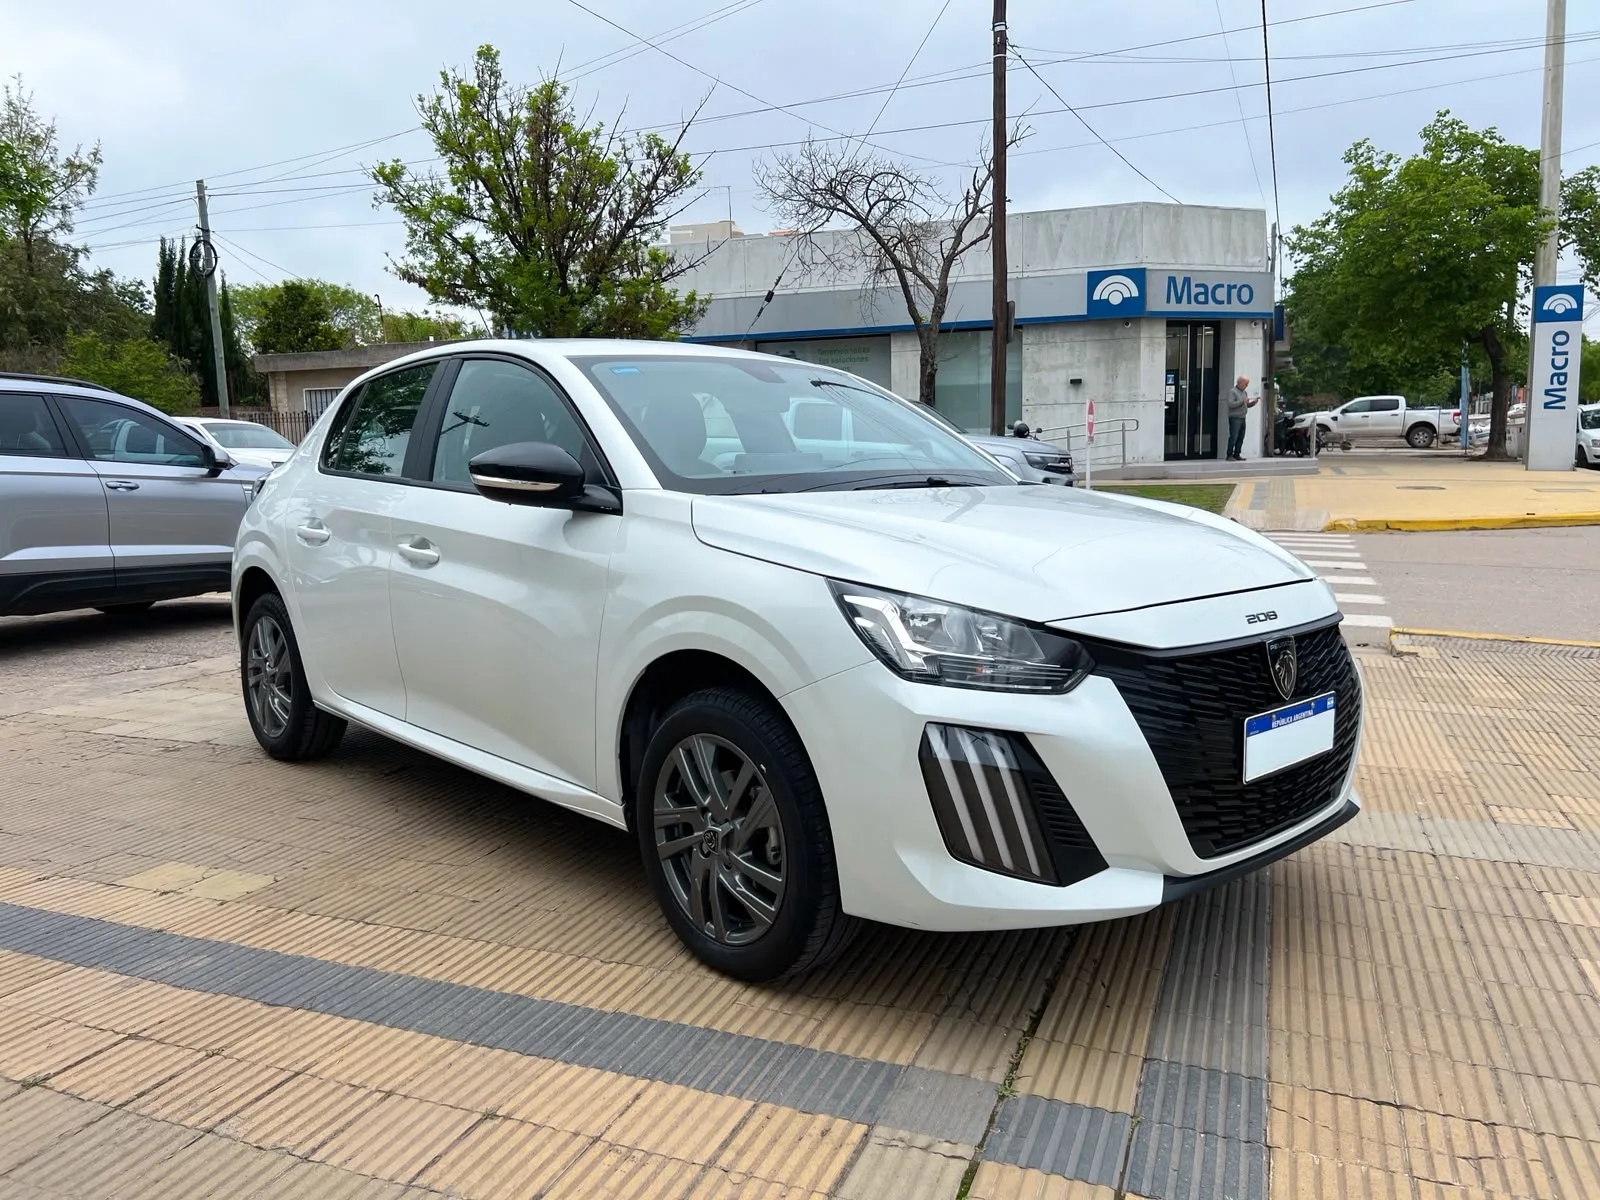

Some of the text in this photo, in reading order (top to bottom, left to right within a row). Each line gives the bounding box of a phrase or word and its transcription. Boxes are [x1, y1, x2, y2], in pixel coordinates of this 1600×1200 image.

[1166, 275, 1254, 305] Macro
[1543, 330, 1570, 410] Macro
[1245, 610, 1278, 625] 208
[1293, 708, 1314, 722] ARGENTINA
